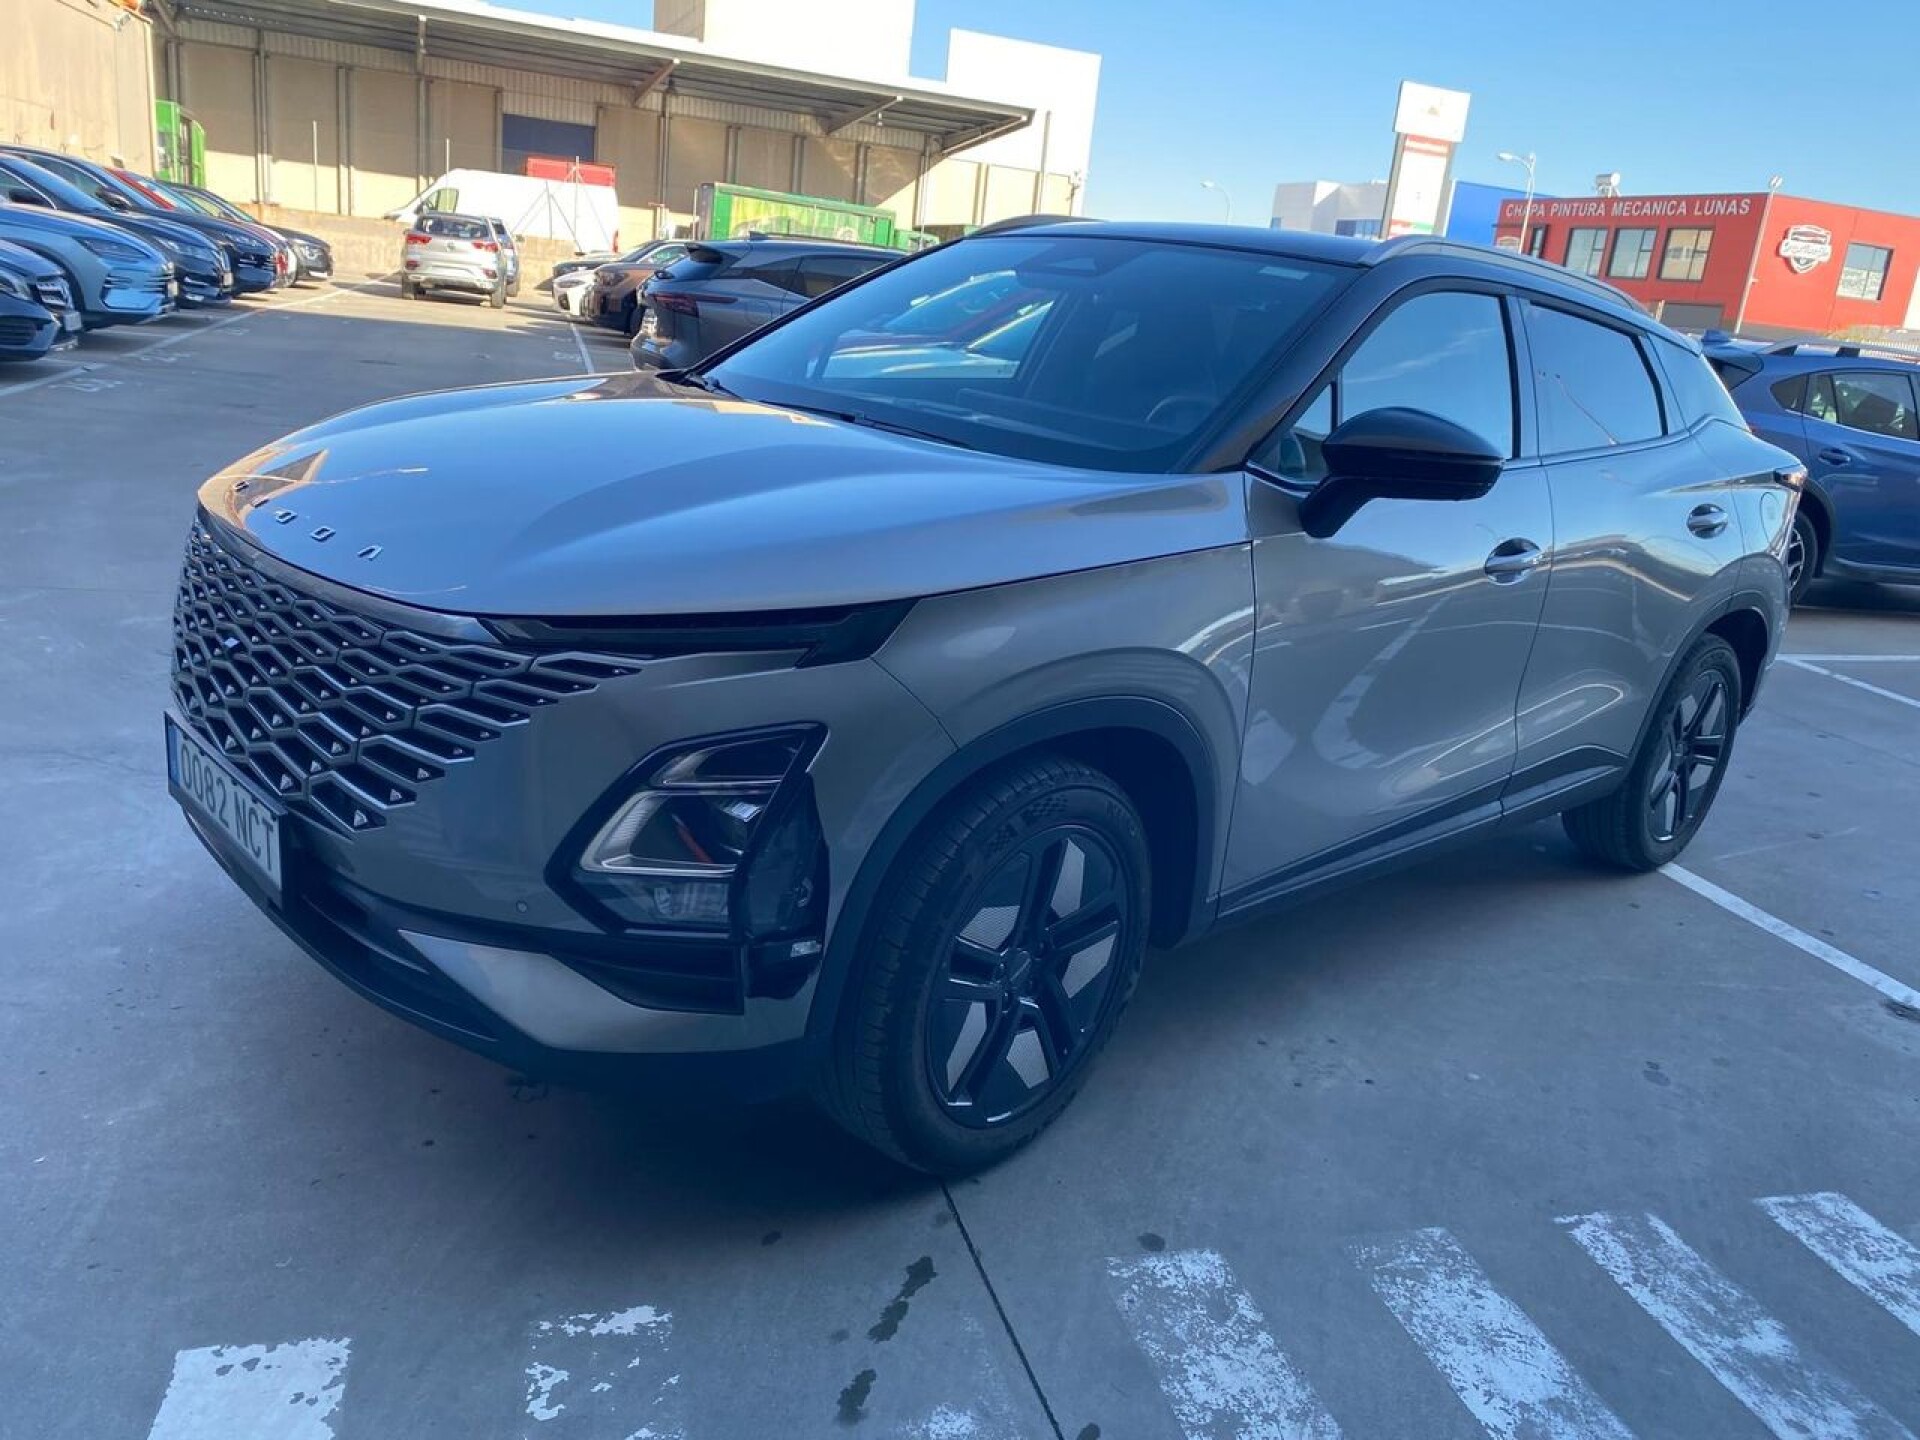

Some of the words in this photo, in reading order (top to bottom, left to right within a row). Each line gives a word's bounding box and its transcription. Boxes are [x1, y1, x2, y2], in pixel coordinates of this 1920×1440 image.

[1550, 202, 1606, 217] PINTURA
[1610, 200, 1687, 217] MECANICA
[1694, 198, 1751, 216] LUNAS
[181, 743, 230, 829] 0082
[233, 791, 274, 871] NCT
